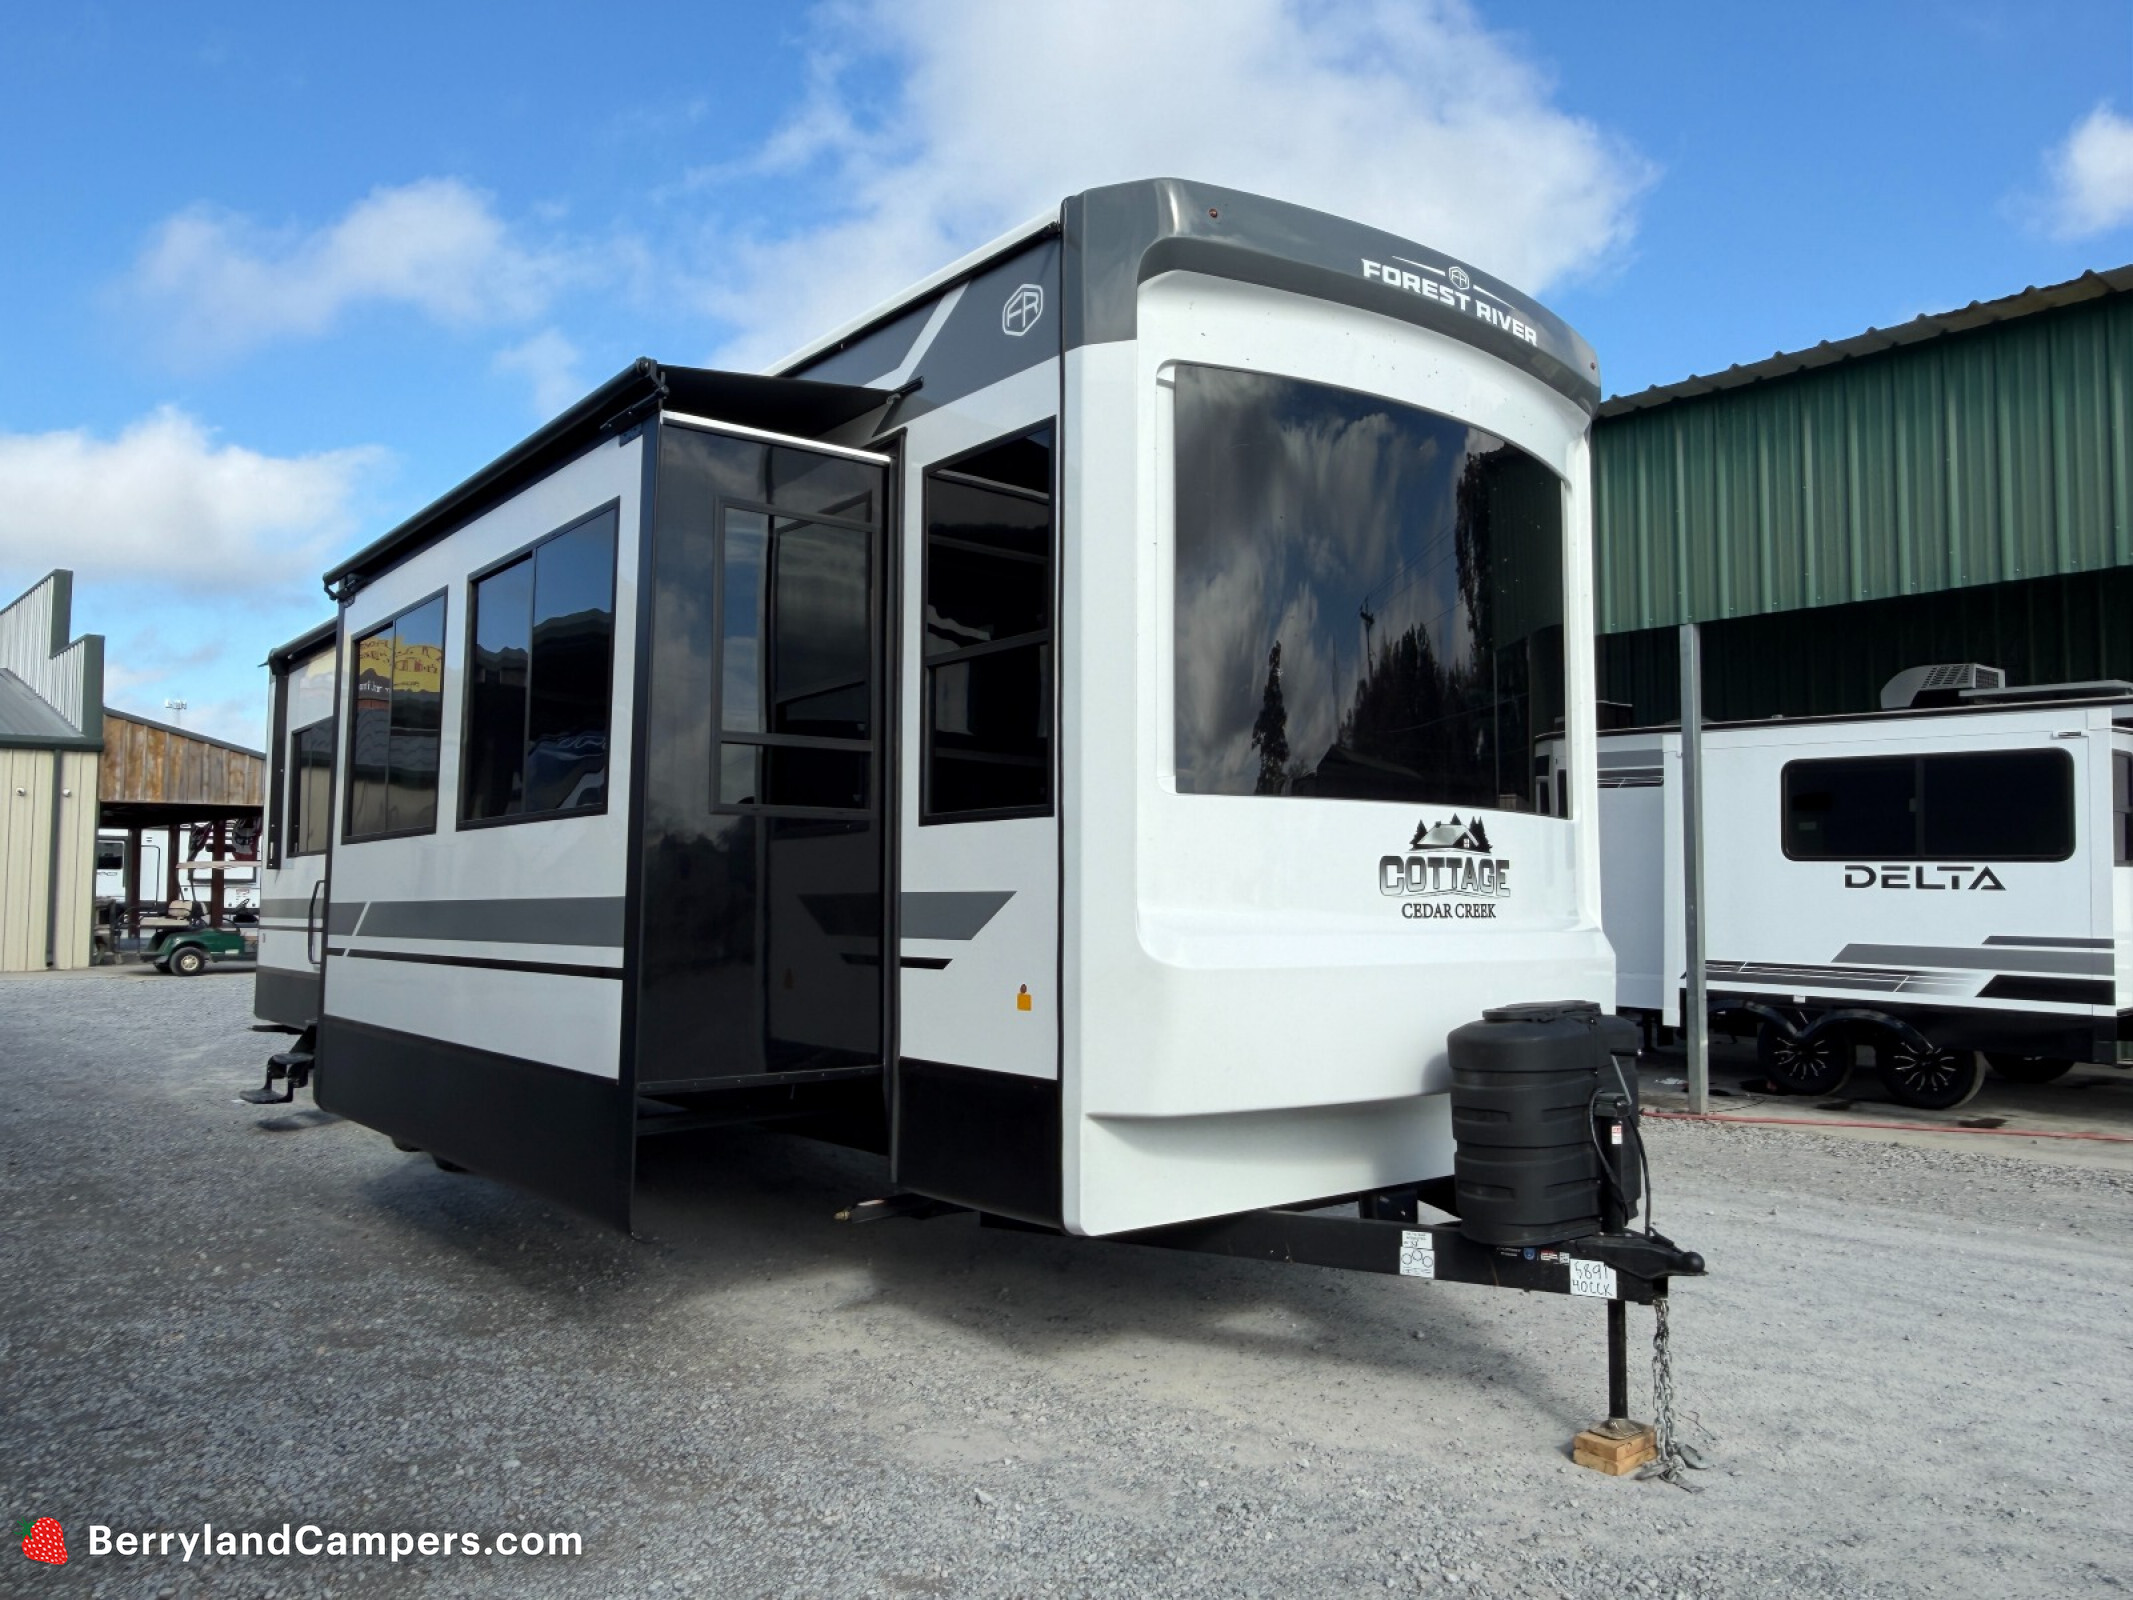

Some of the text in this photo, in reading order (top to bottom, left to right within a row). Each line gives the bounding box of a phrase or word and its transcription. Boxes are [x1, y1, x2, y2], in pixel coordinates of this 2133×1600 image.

[1361, 258, 1537, 346] FOREST RIVER
[1379, 855, 1511, 897] COTTAGE
[1844, 864, 2006, 891] DELTA
[1401, 903, 1497, 919] CEDAR CREEK
